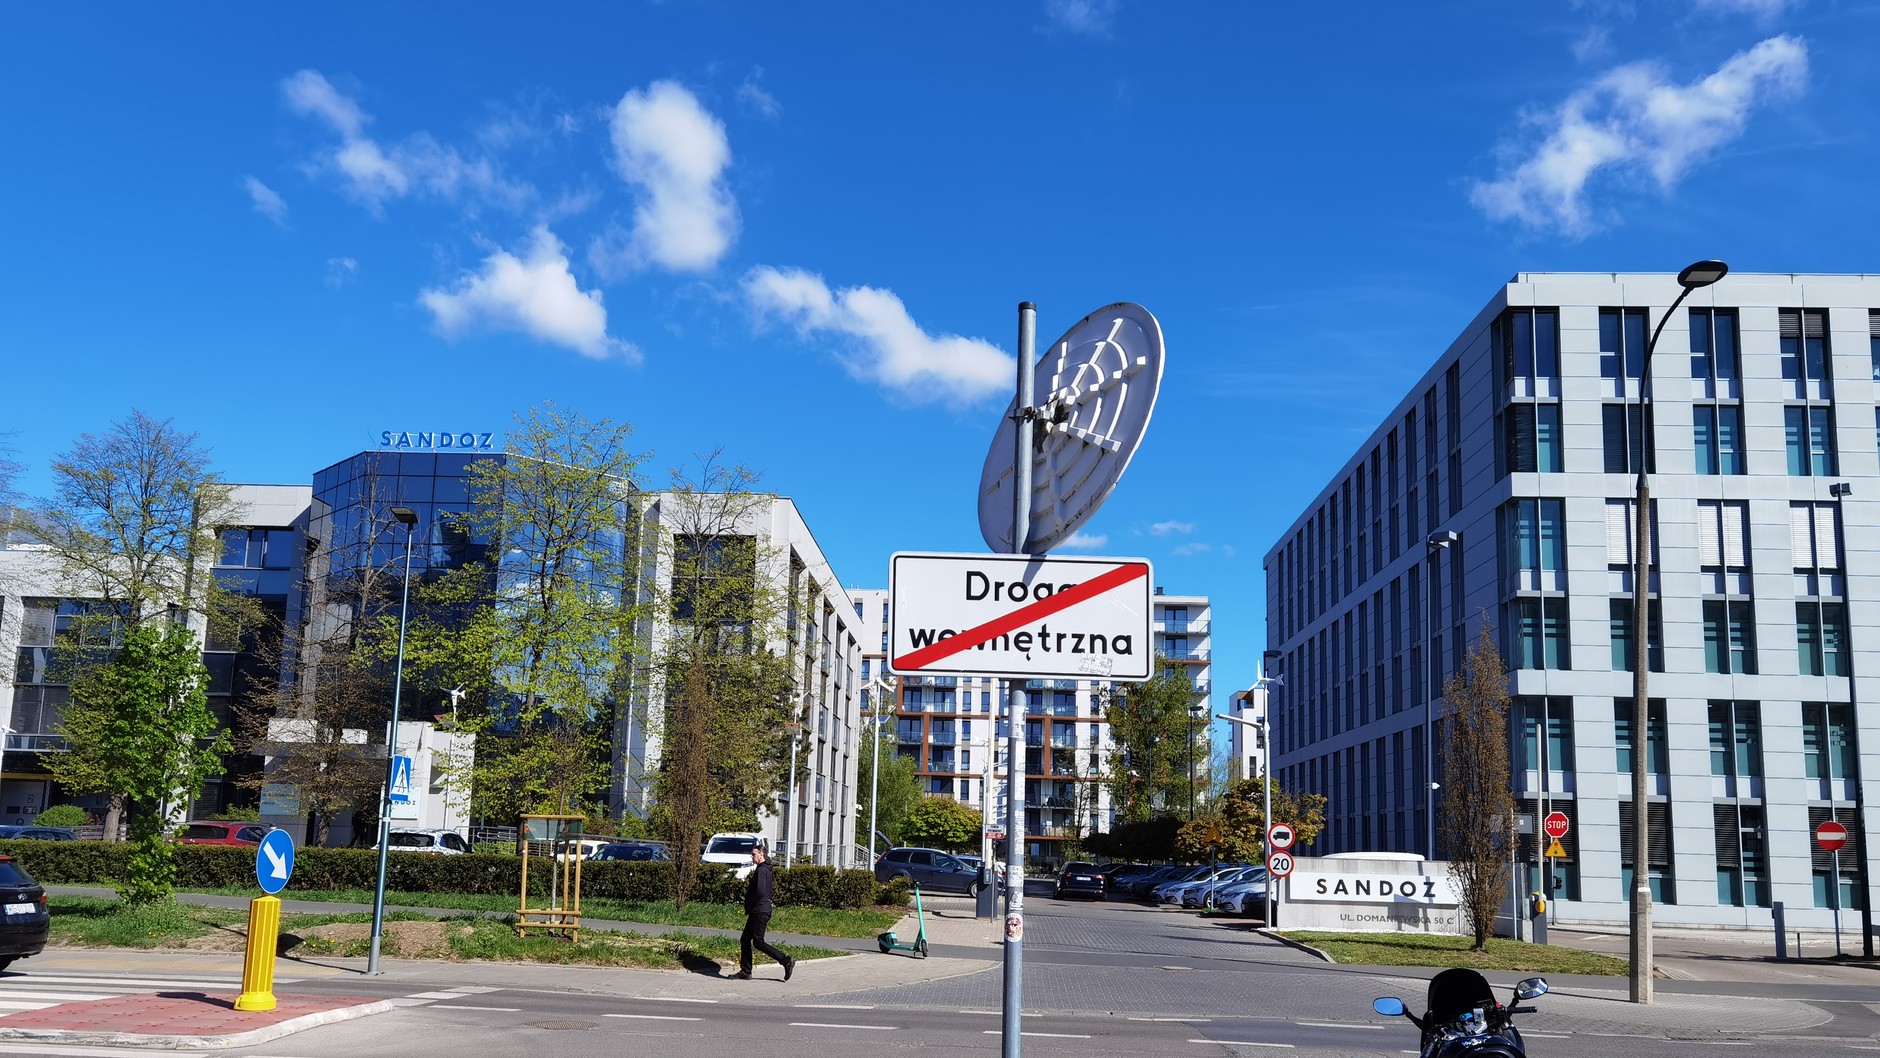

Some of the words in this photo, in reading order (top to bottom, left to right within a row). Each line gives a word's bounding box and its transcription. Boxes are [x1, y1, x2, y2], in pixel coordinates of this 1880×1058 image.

[381, 430, 494, 449] SANDOZ
[909, 624, 1132, 660] wnętrzna
[1547, 820, 1566, 829] STOP
[1273, 857, 1289, 871] 20
[1316, 878, 1436, 898] SANDOZ
[1356, 914, 1432, 925] DOMANIEWSKA
[1434, 917, 1444, 925] 50
[1446, 917, 1454, 925] C
